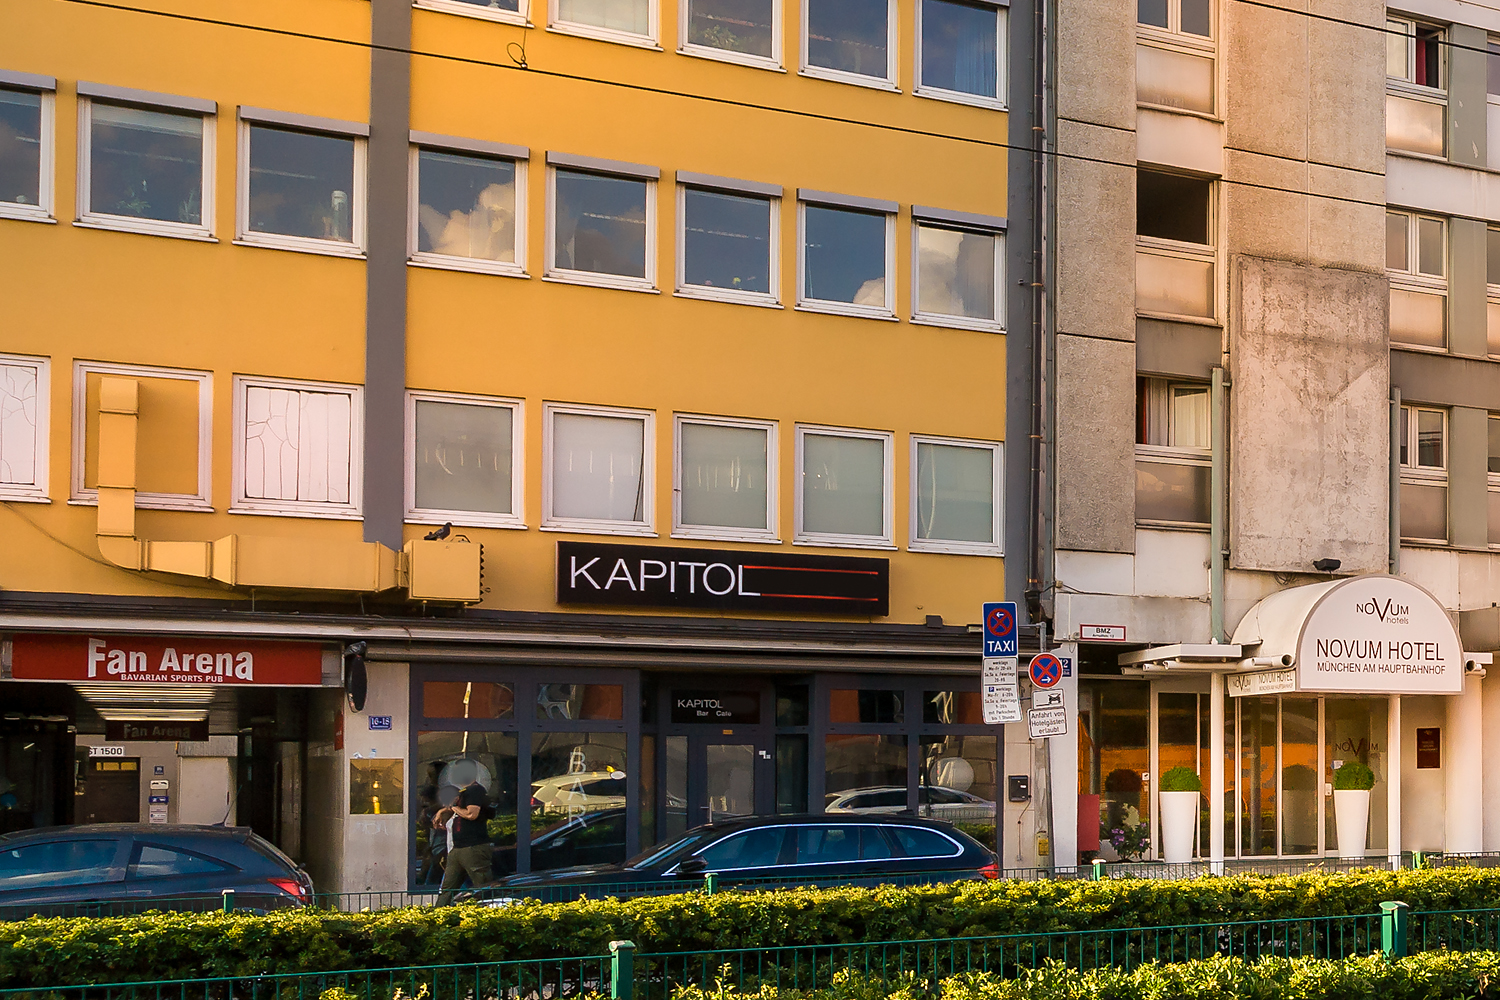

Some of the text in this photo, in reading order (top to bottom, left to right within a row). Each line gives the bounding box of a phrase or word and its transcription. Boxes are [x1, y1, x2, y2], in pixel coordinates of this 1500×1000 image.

[570, 555, 761, 597] KAPITOL
[1356, 597, 1409, 622] NOVUM
[1386, 616, 1409, 625] hotels
[986, 640, 1015, 653] TAXI
[1316, 638, 1445, 661] NOVUM HOTEL
[87, 637, 254, 682] Fan Arena
[1317, 661, 1446, 675] MÜNCHEN AM HAUPTBAHNHOF
[120, 673, 224, 683] BAVARIAN SPORTS PUB
[677, 699, 724, 709] KAPITOL
[1031, 711, 1053, 719] Anfahrt
[123, 722, 191, 739] Fan Arena
[100, 747, 123, 755] 1500
[567, 751, 588, 828] BAR
